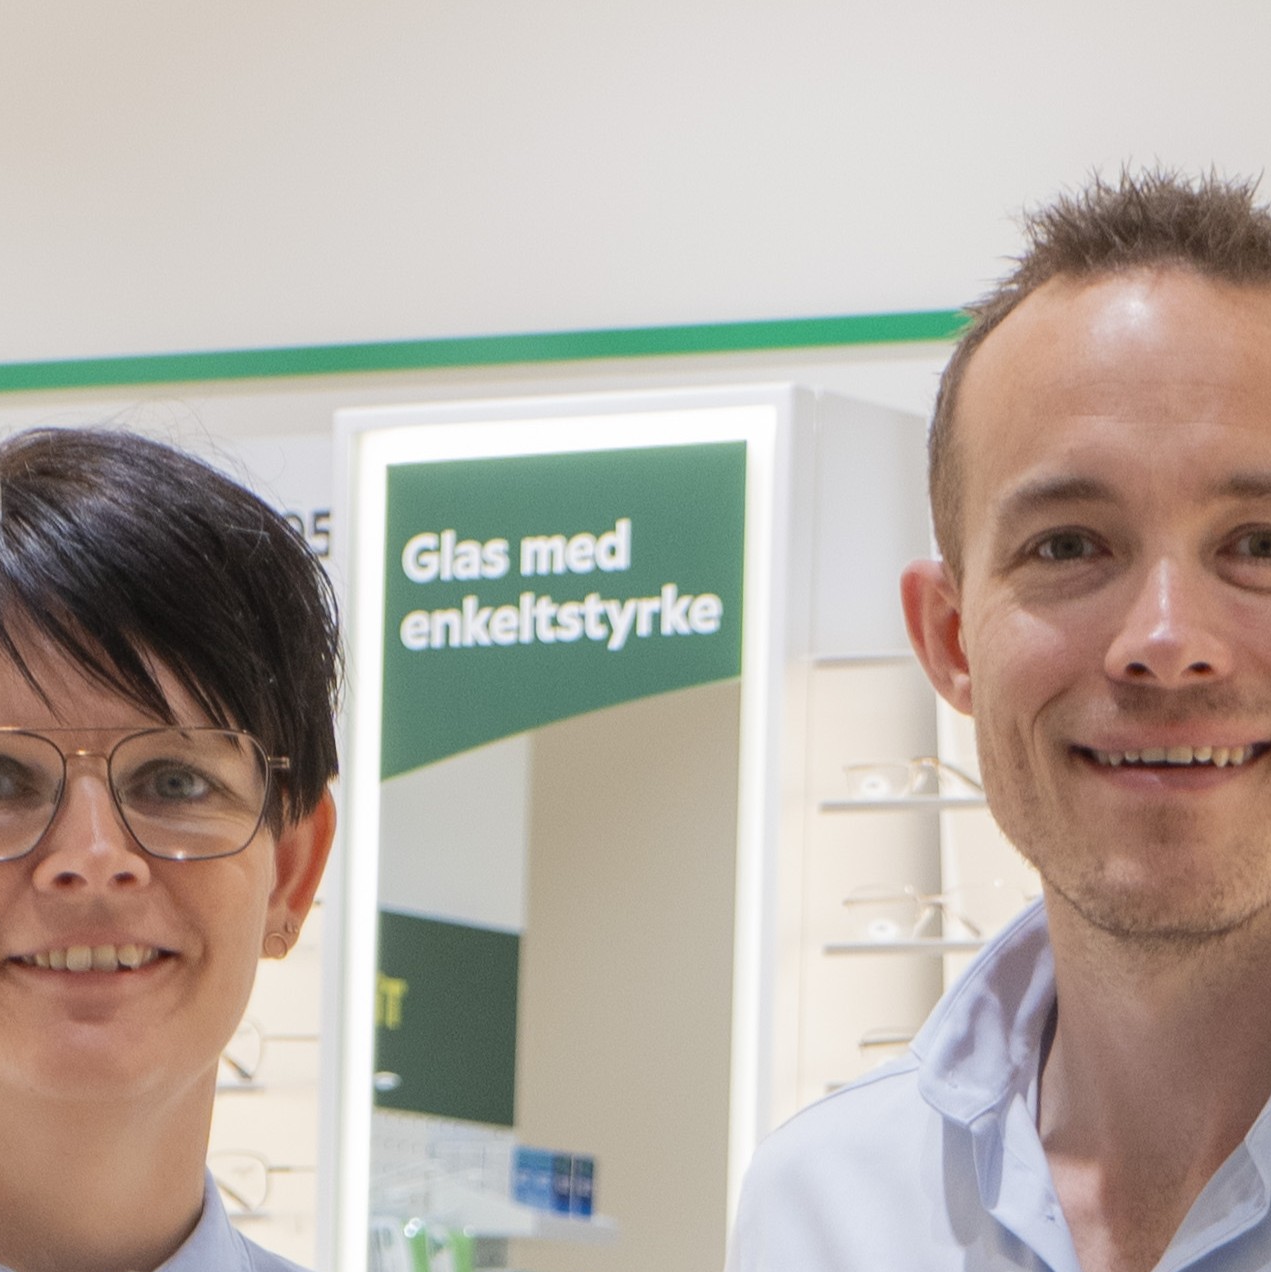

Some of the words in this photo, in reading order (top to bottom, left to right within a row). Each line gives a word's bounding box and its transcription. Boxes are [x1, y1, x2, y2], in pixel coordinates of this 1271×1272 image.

[401, 529, 510, 584] Glas
[520, 518, 632, 577] med
[400, 583, 723, 651] enkeltstyrke
